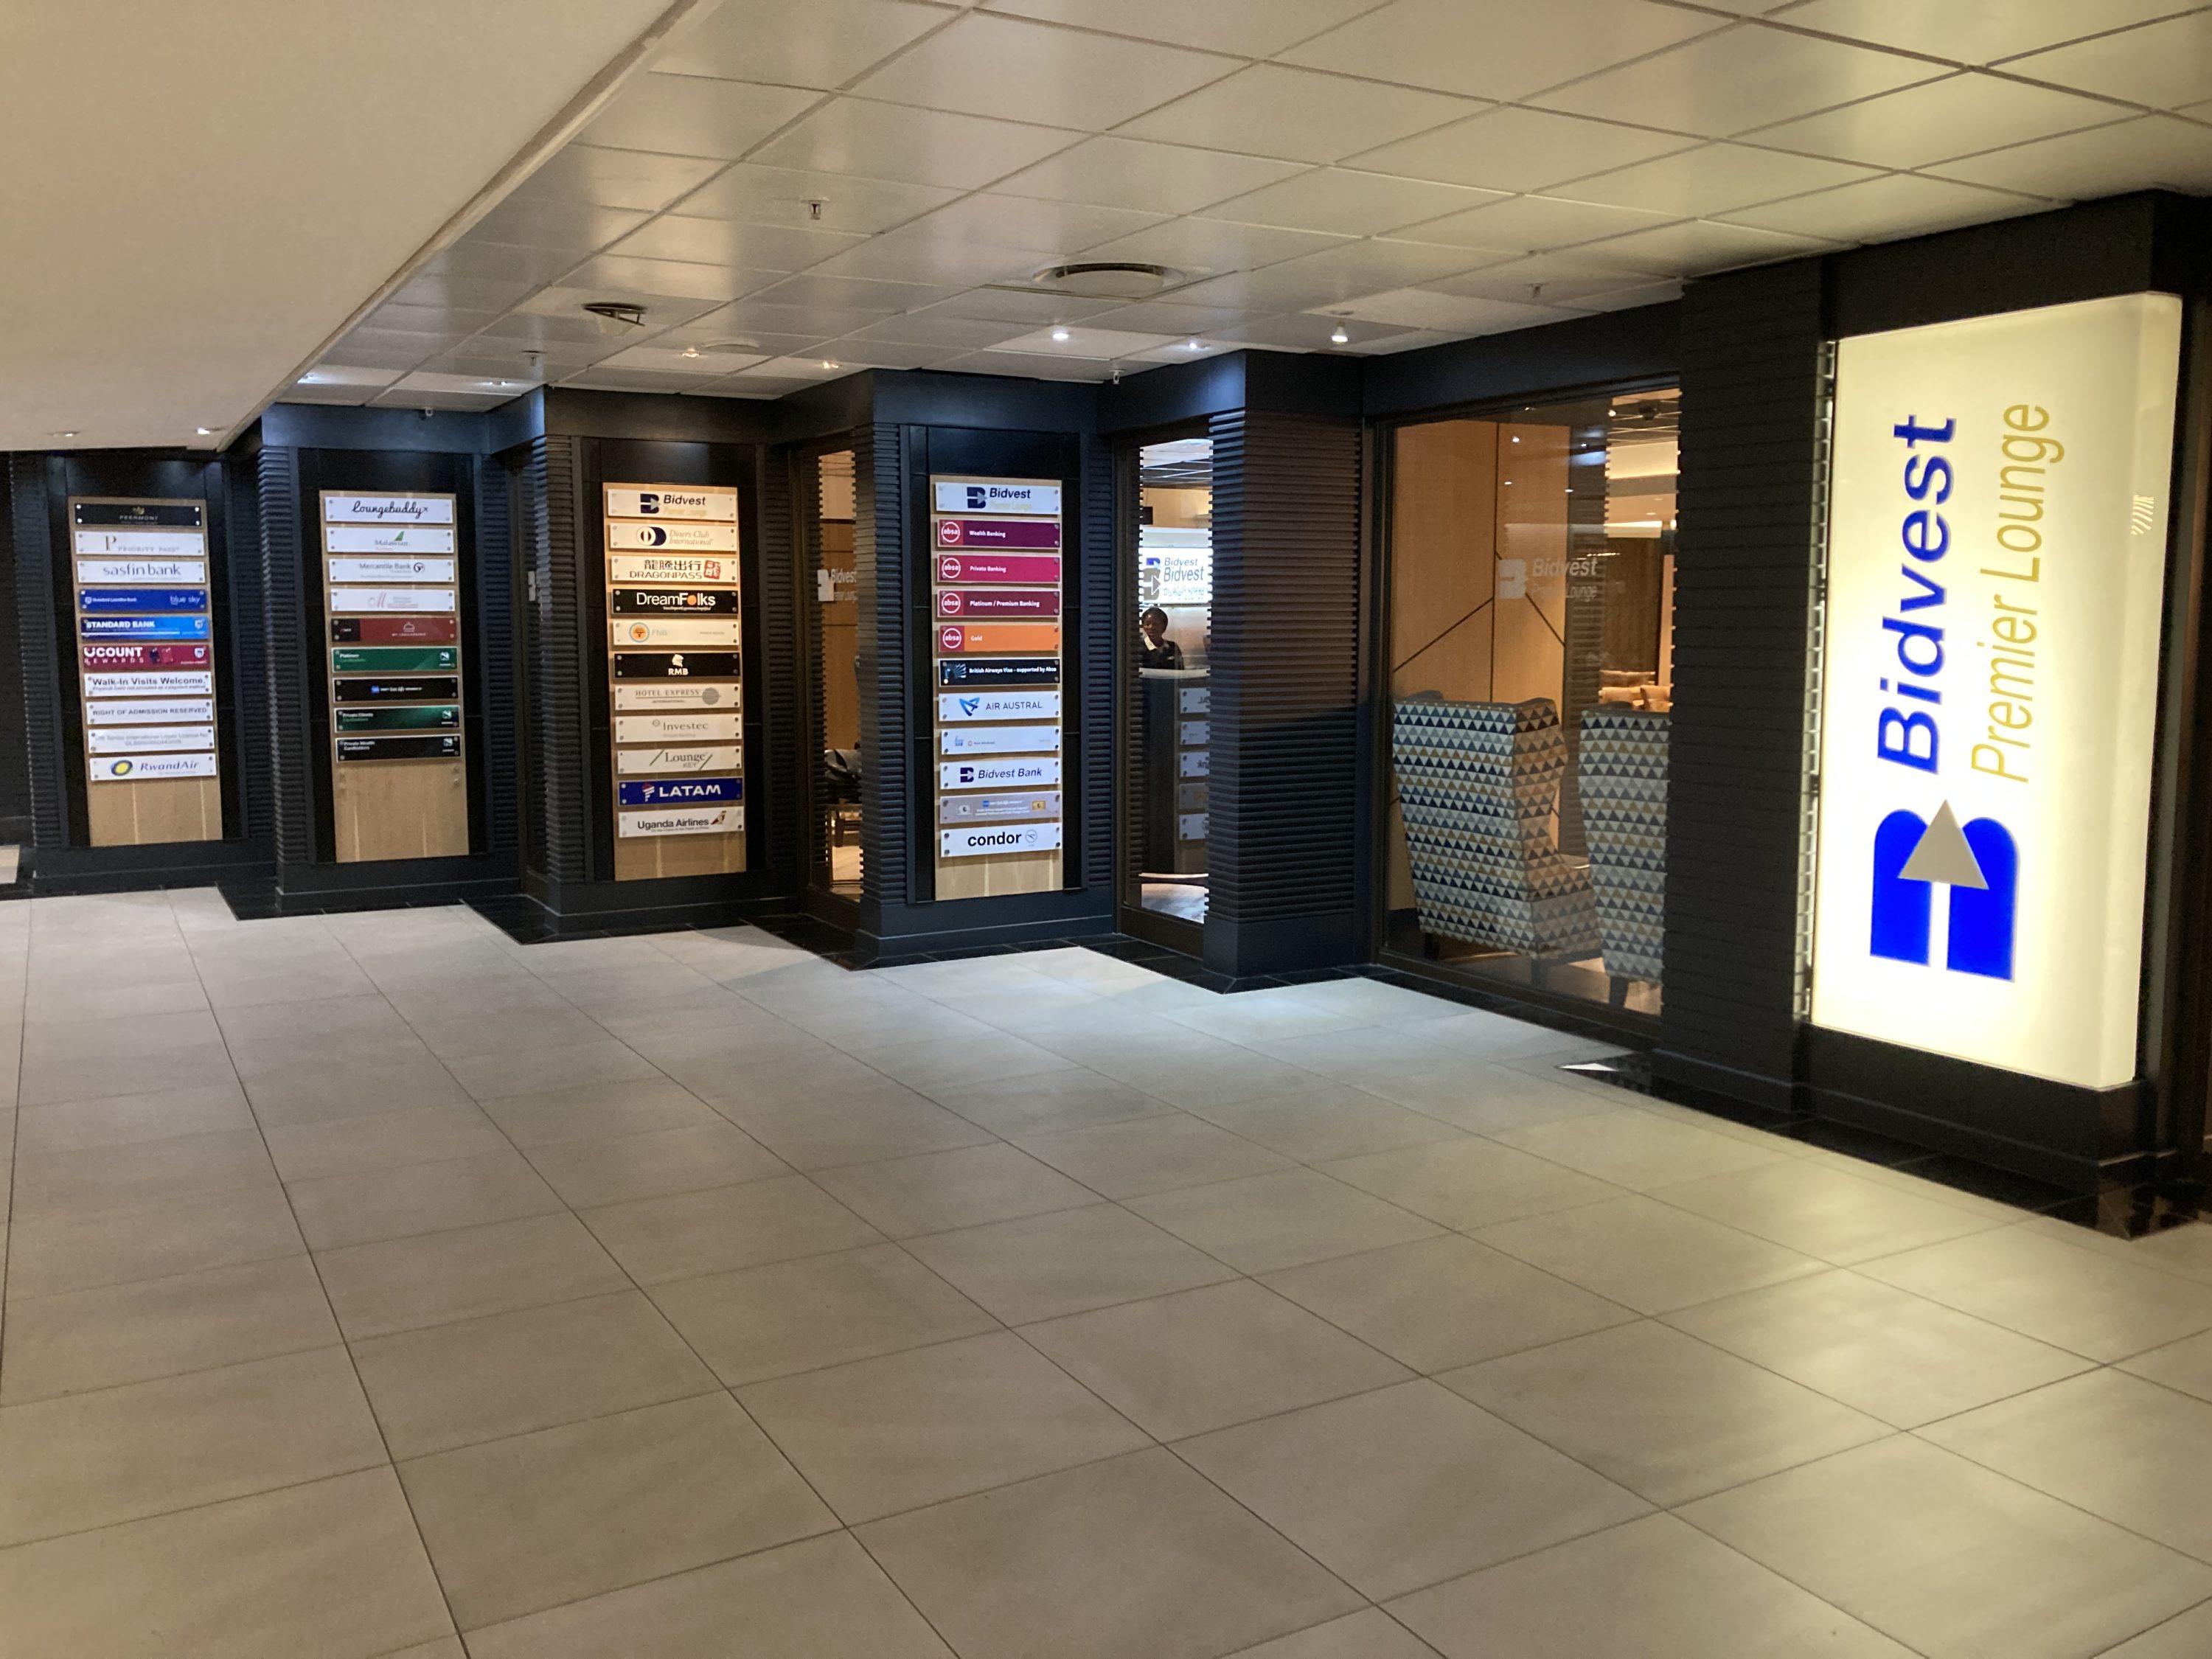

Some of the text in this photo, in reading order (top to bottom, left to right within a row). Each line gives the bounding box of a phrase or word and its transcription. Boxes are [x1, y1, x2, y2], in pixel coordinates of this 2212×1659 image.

[990, 488, 1031, 498] Bidvest
[664, 495, 706, 506] Bidvest
[693, 530, 710, 538] Club
[1164, 557, 1198, 566] Bidvest
[1533, 557, 1598, 576] Bidvest
[103, 563, 181, 576] sasfin bank
[1164, 566, 1205, 582] Bidvest
[630, 571, 702, 580] DRAGONPASS
[636, 592, 716, 606] DreamFolks
[1877, 414, 1956, 774] Bidvest
[1971, 404, 2065, 783] Premier Lounge
[86, 620, 156, 628] STANDARD BANK
[83, 647, 143, 658] UCOUNT
[92, 677, 128, 686] Walk-In
[132, 677, 157, 686] Visits
[986, 701, 1043, 710] AIR AUSTRAL
[664, 722, 709, 731] Investec
[665, 752, 705, 762] Lounge
[140, 761, 198, 771] RwandAir
[978, 768, 1042, 779] Bidvest Bank
[659, 785, 721, 798] LATAM
[637, 821, 674, 830] Uganda
[675, 818, 709, 827] Airlines
[967, 832, 1022, 846] condor
